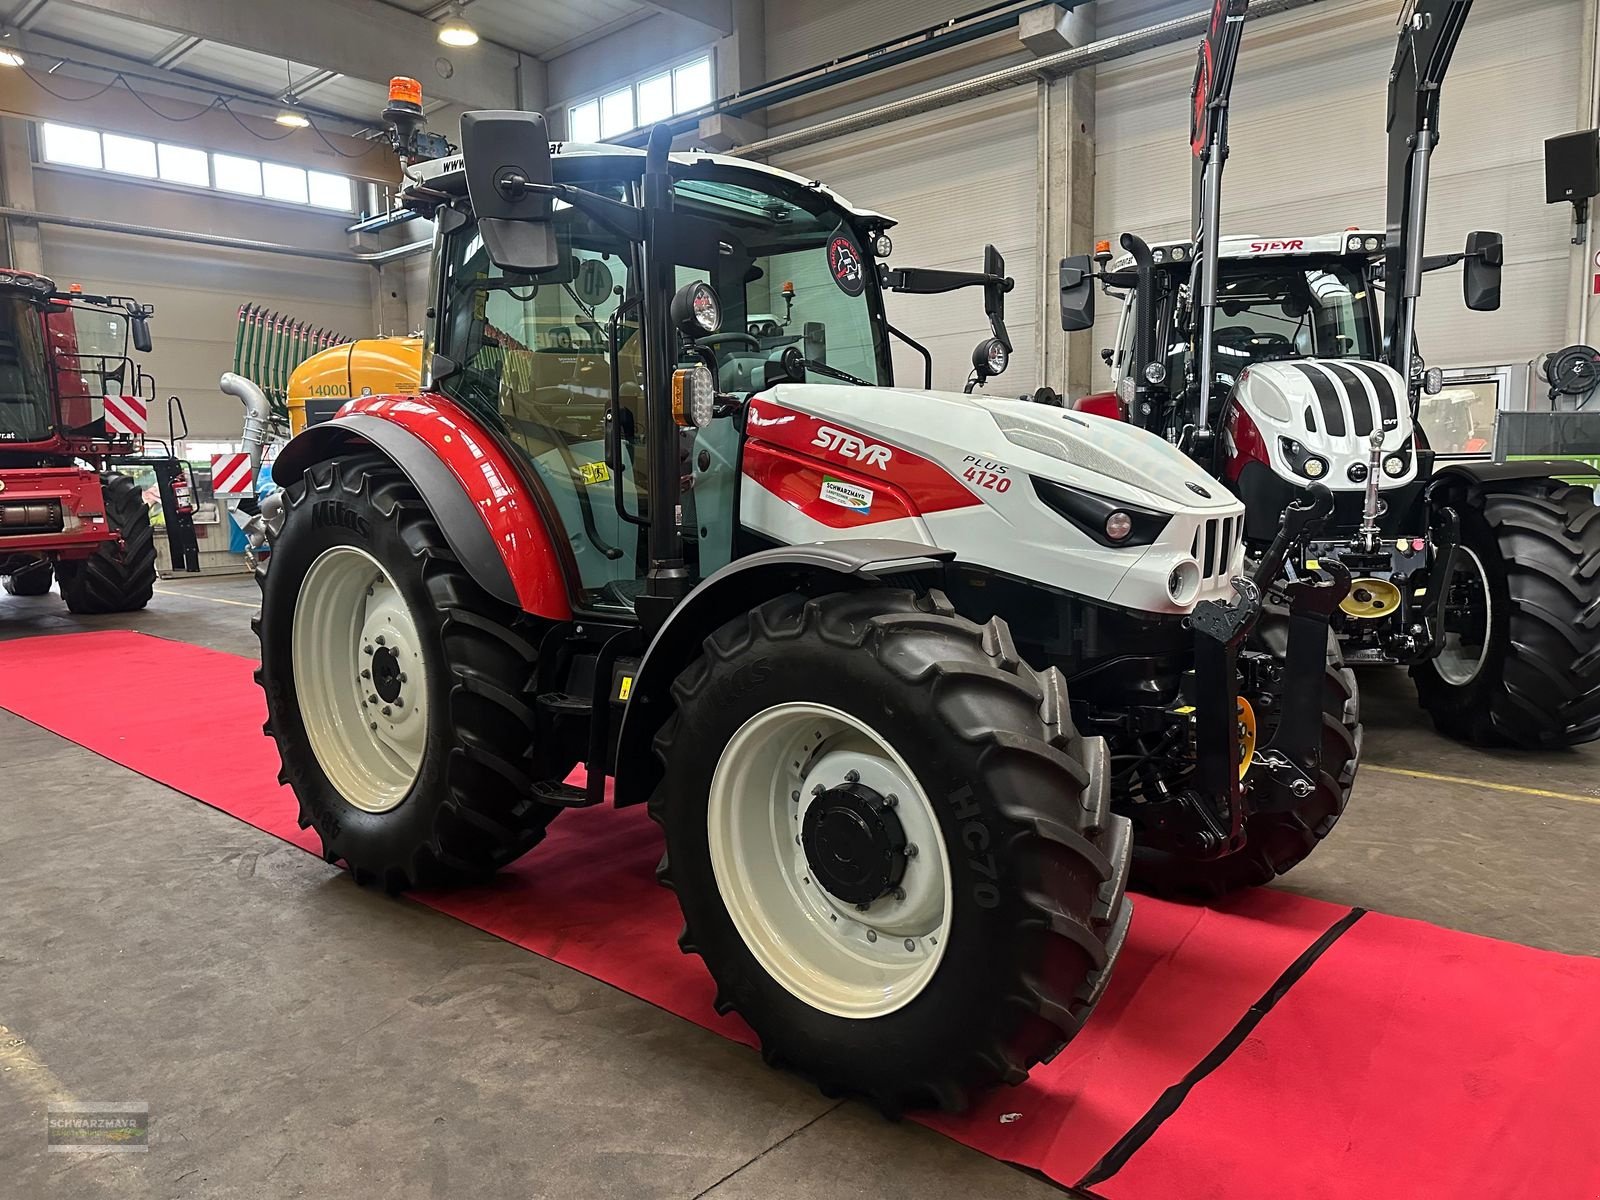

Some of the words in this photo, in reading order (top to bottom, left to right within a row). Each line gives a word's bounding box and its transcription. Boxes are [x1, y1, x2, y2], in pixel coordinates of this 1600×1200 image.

[1249, 240, 1304, 253] STEYR
[308, 384, 347, 397] 14000
[810, 426, 893, 471] STEYR
[963, 455, 1010, 474] PLUS
[963, 466, 1012, 493] 4120
[826, 482, 866, 500] SCHWARZMAYR
[948, 784, 1001, 909] HC70
